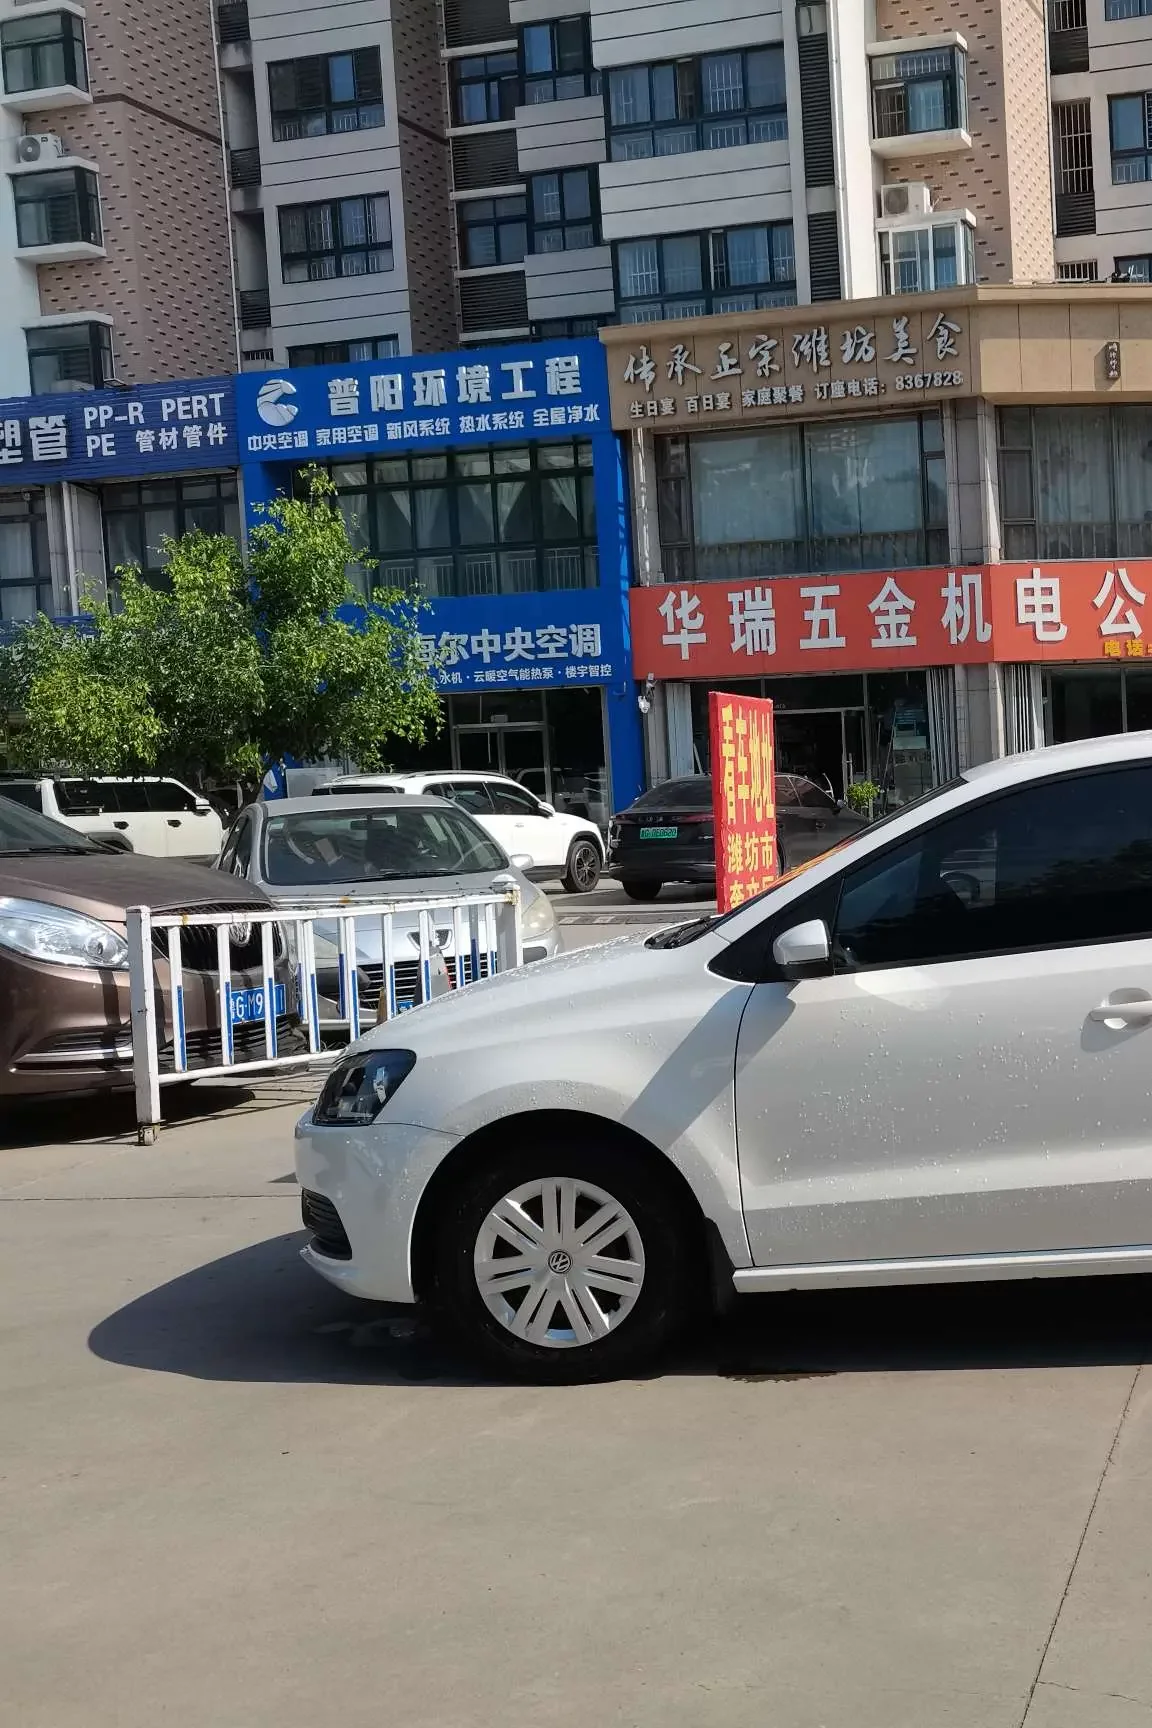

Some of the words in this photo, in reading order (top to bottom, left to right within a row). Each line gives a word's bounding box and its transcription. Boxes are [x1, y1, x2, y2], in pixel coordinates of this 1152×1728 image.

[328, 354, 583, 417] 普阳环境工程
[629, 396, 676, 419] 生日宴
[685, 391, 731, 413] 百日宴
[741, 384, 805, 408] 家庭聚餐
[895, 369, 963, 391] 8367828
[83, 402, 145, 430] PP-R
[161, 392, 225, 422] PERT
[247, 430, 309, 452] 中央空调
[316, 423, 379, 446] 家用空调
[386, 417, 451, 440] 新风系统
[459, 411, 525, 434] 热水系统
[533, 403, 601, 427] 全屋净水
[86, 433, 117, 458] PE
[135, 421, 229, 454] 管材管件
[727, 830, 775, 876] 潍坊市
